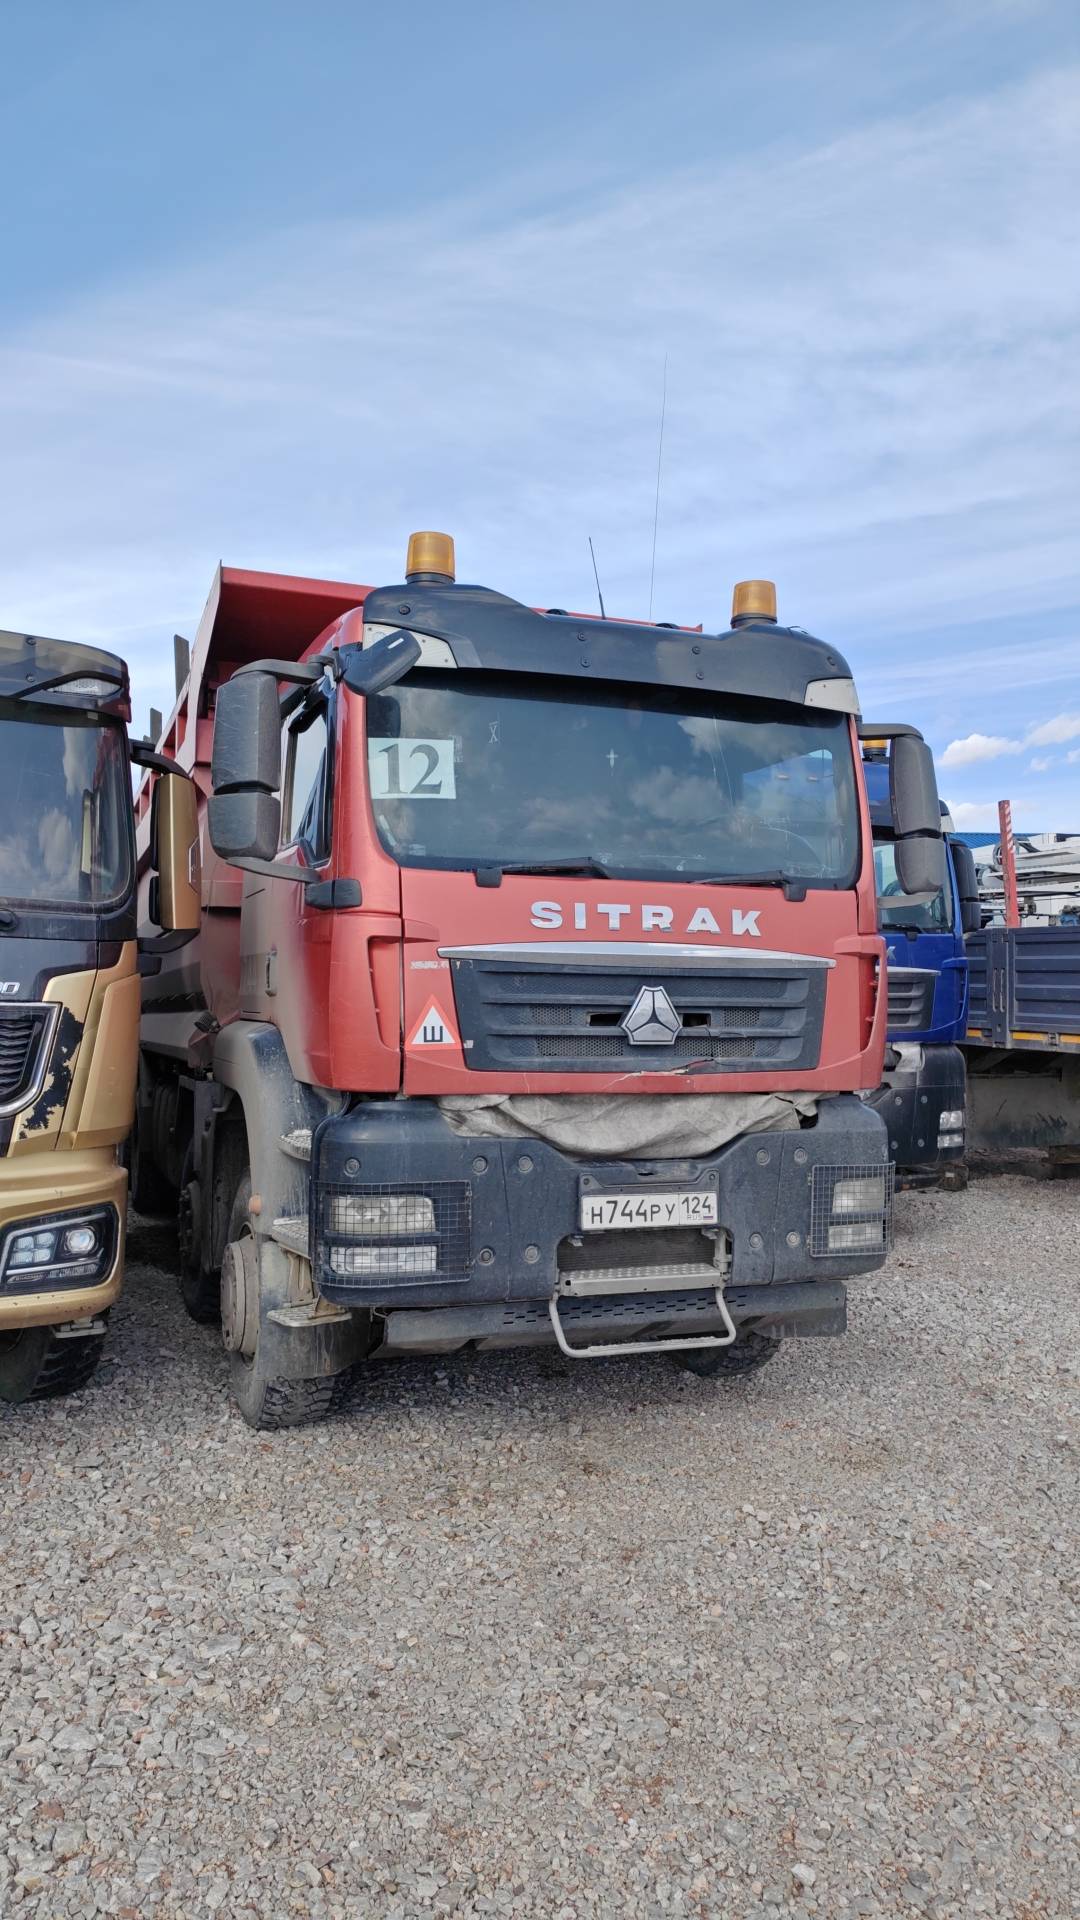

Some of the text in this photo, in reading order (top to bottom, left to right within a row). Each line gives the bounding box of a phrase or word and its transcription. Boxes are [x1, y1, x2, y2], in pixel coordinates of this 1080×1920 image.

[378, 743, 442, 795] 12
[530, 901, 762, 937] SITRAK
[423, 1025, 443, 1043] Ш
[681, 1195, 712, 1215] 124
